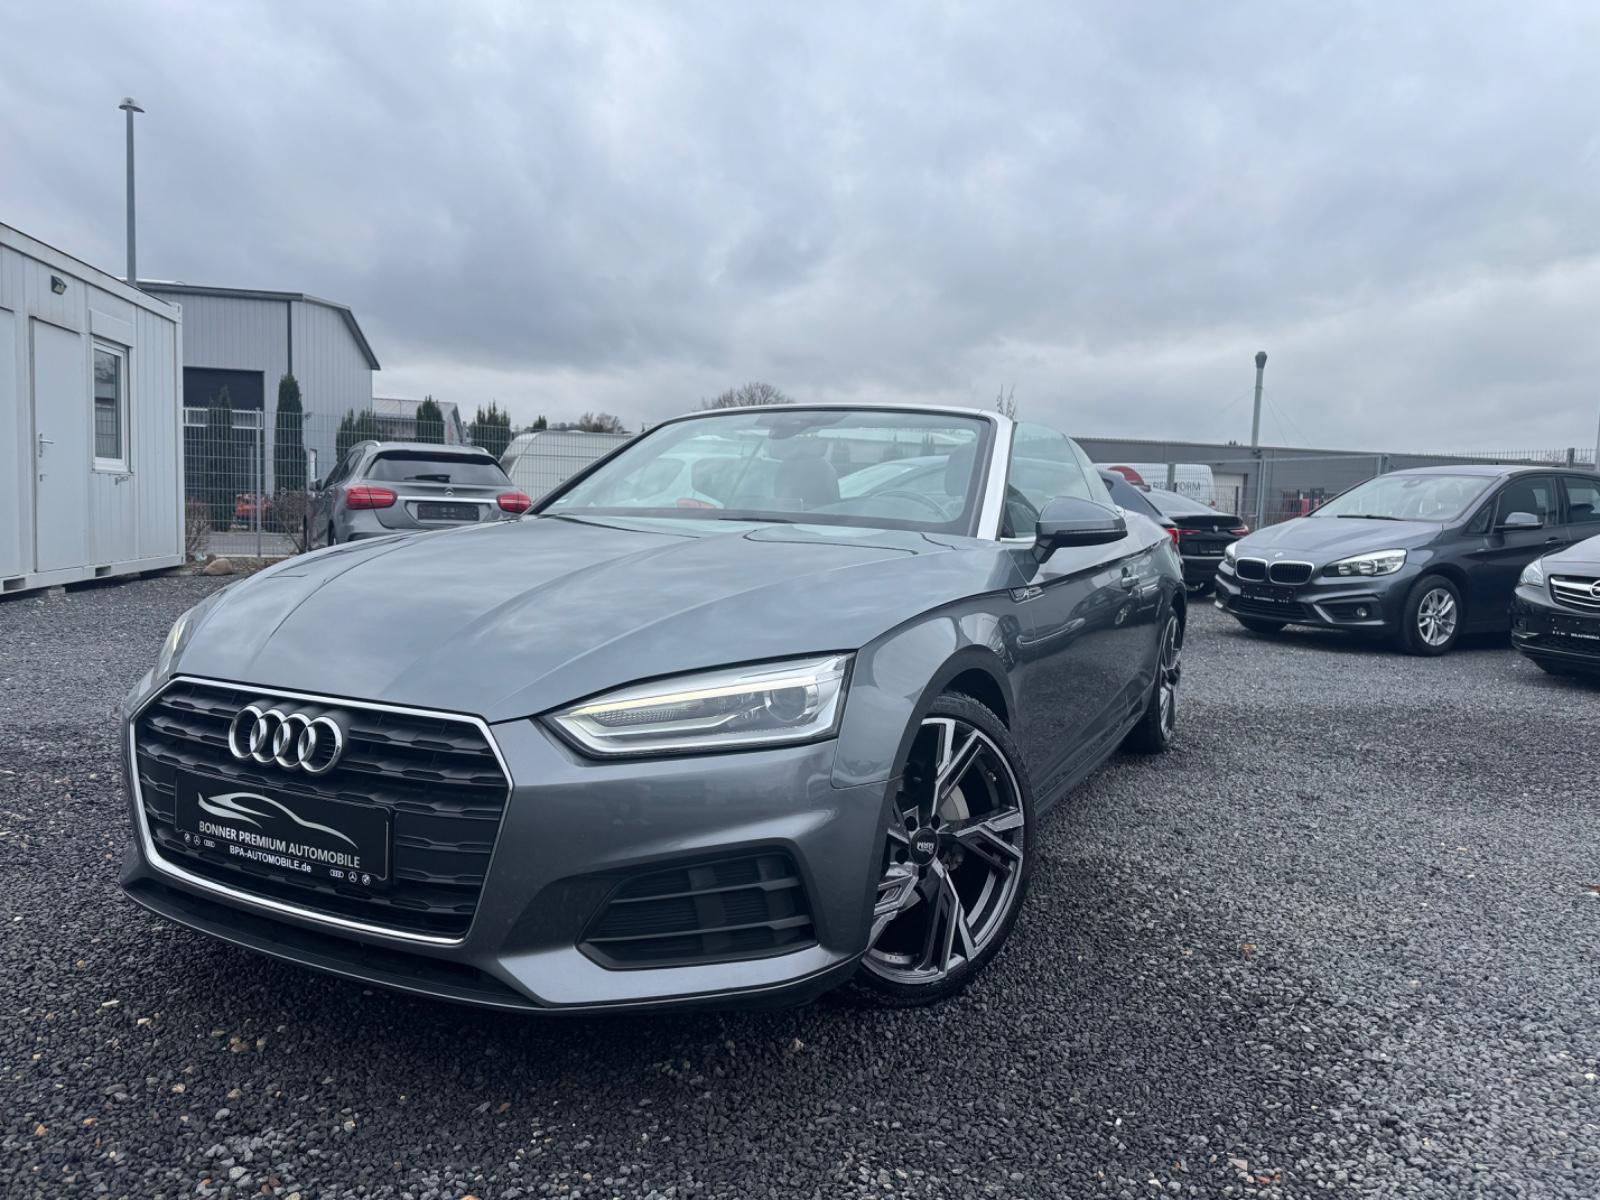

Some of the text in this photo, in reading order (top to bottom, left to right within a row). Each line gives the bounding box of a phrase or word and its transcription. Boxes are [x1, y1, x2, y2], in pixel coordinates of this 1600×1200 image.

[199, 820, 361, 869] BONNER PREMIUM AUTOMOBILE
[229, 845, 312, 873] BPA-AUTOMOBILE.de
